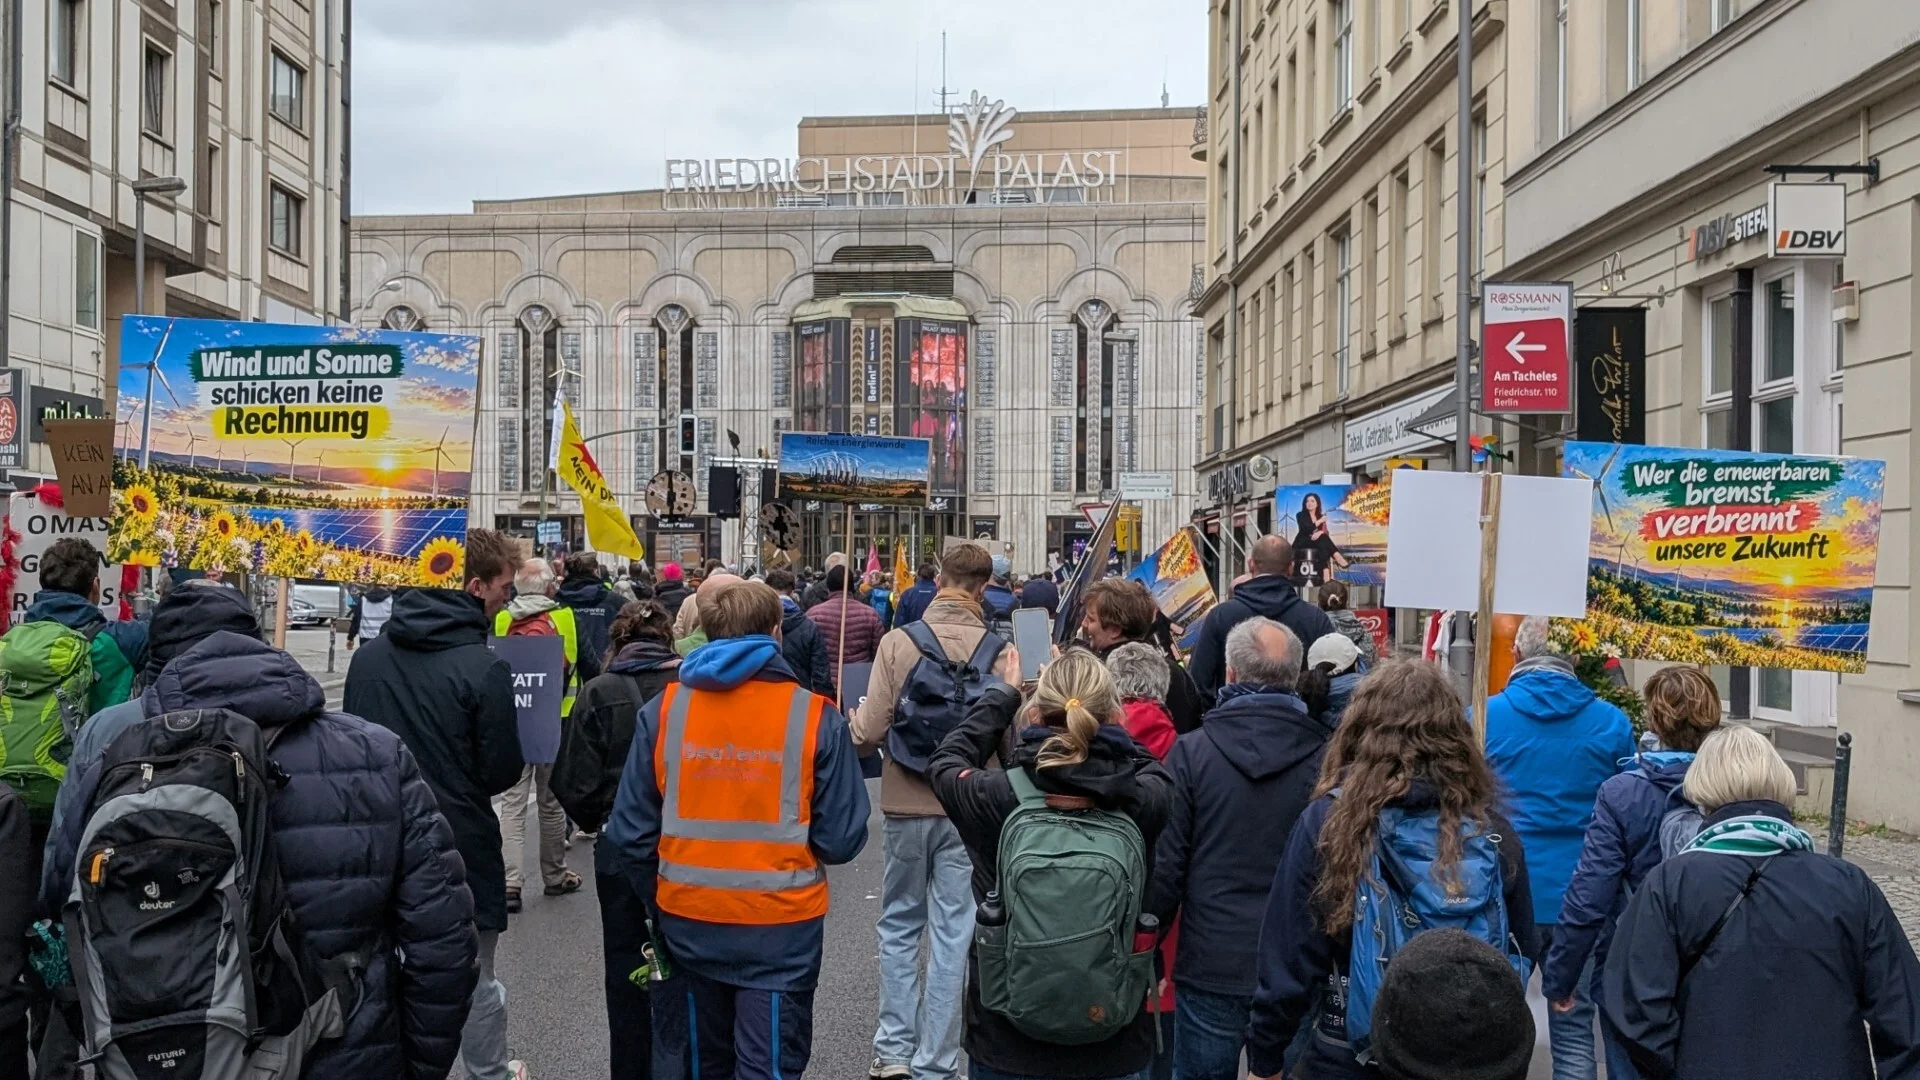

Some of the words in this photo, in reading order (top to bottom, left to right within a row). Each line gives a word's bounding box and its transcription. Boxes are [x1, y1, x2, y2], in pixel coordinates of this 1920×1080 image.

[665, 154, 956, 194] FRIEDRICHSTADT
[994, 150, 1123, 188] PALAST
[1789, 230, 1843, 248] DBV
[1490, 292, 1562, 304] ROSSMANN
[201, 350, 262, 377] Wind
[266, 350, 310, 376] und
[315, 348, 392, 375] Sonne
[1494, 371, 1511, 381] Am
[1512, 370, 1558, 381] Tacheles
[211, 381, 310, 405] schicken
[317, 380, 383, 403] keine
[1494, 387, 1542, 397] Friedrichstr.
[1544, 387, 1557, 396] 110
[1494, 398, 1519, 407] Berlin
[225, 405, 369, 439] Rechnung
[806, 436, 839, 446] Reiches
[841, 437, 906, 449] Energiewende
[1347, 430, 1364, 454] Tabak,
[1366, 421, 1394, 449] Getränke,
[0, 455, 15, 466] AR
[571, 456, 596, 494] NEIN
[1634, 464, 1675, 487] Wer
[1679, 461, 1707, 482] die
[1713, 460, 1830, 482] erneuerbaren
[1685, 481, 1781, 506] bremst,
[28, 515, 109, 534] OMAS
[1655, 504, 1801, 538] verbrennt
[1656, 538, 1727, 562] unsere
[1731, 533, 1830, 562] Zukunft
[1300, 562, 1318, 575] ÖL
[140, 900, 175, 910] deuter
[147, 1048, 186, 1062] FUTURA
